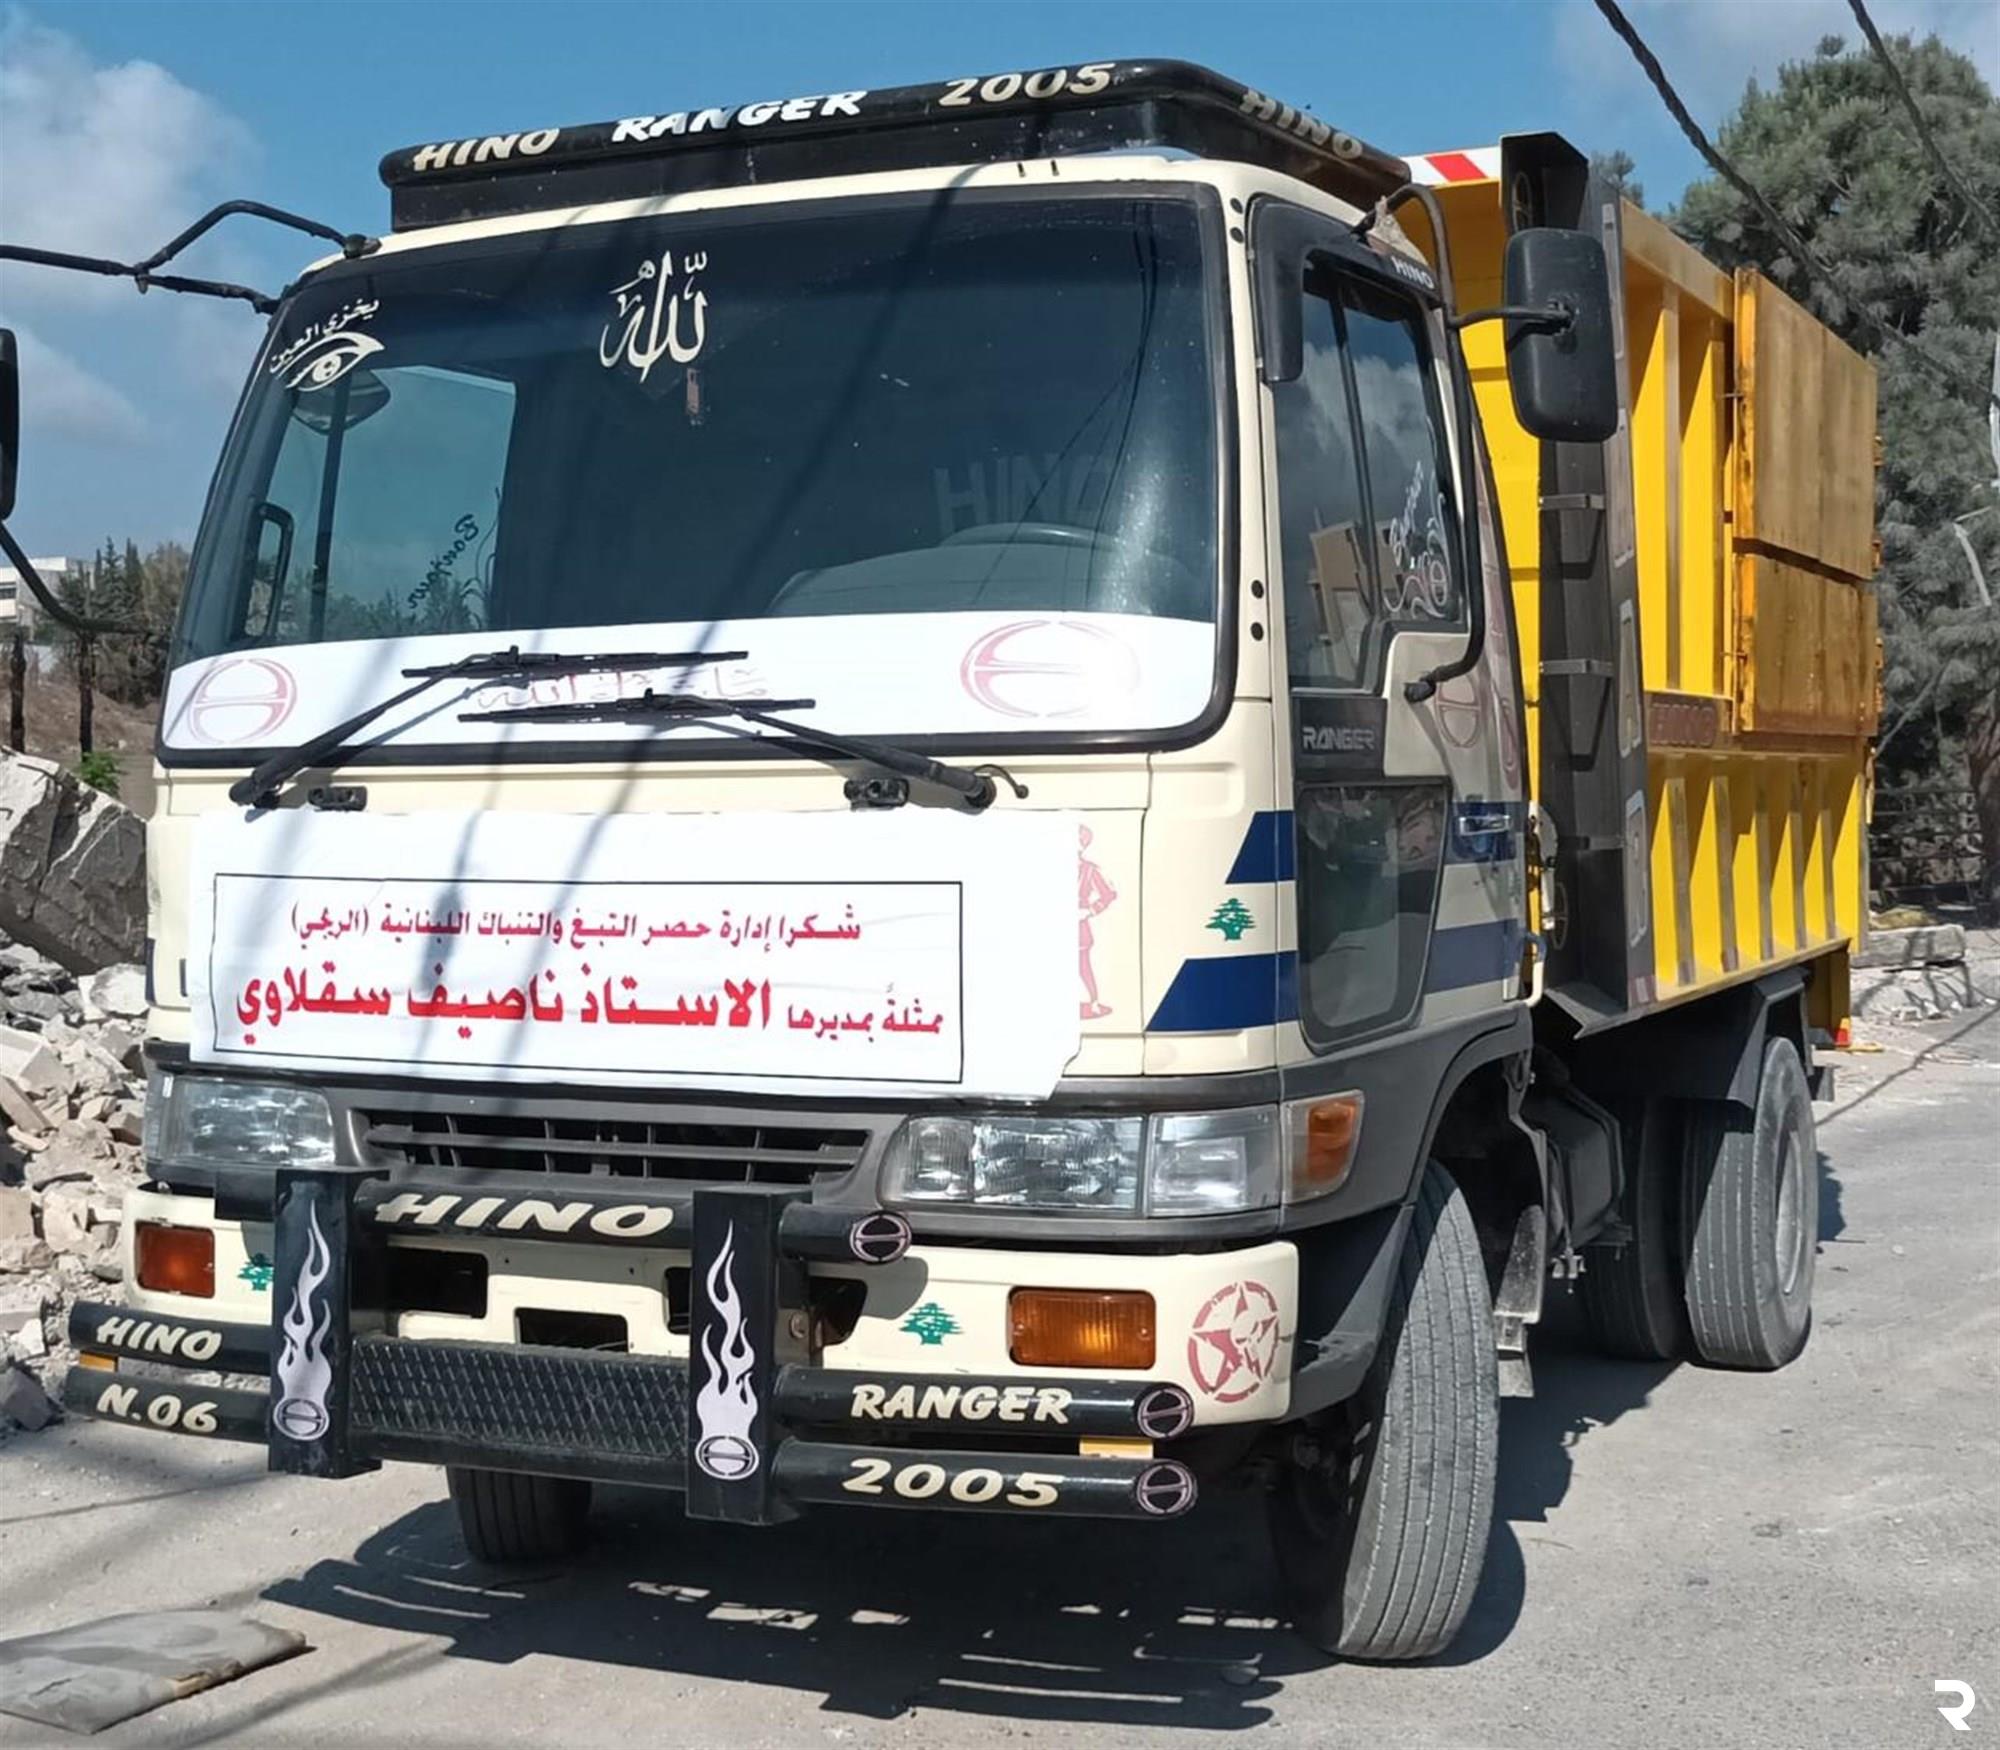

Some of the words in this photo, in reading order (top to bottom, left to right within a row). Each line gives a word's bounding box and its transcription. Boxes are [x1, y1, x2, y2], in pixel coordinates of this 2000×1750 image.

[412, 127, 559, 172] HINO
[612, 90, 867, 142] RANGER
[938, 62, 1116, 107] 2005
[1238, 87, 1363, 159] HINO
[1390, 255, 1434, 289] HINO
[1303, 725, 1376, 751] RANGER
[380, 902, 471, 943] اللبنانية
[477, 910, 563, 945] والتنباك
[570, 907, 637, 950] التبغ
[642, 920, 711, 946] حصر
[720, 909, 772, 952] إدارة
[779, 902, 861, 948] شكرا
[237, 960, 392, 1046] سقلاوي
[407, 962, 563, 1039] ناصيف
[787, 1004, 875, 1043] بمديرها
[375, 1192, 675, 1239] HINO
[96, 1314, 223, 1362] HINO
[96, 1383, 219, 1434] N.06
[850, 1383, 1072, 1425] RANGER
[842, 1457, 1066, 1507] 2005
